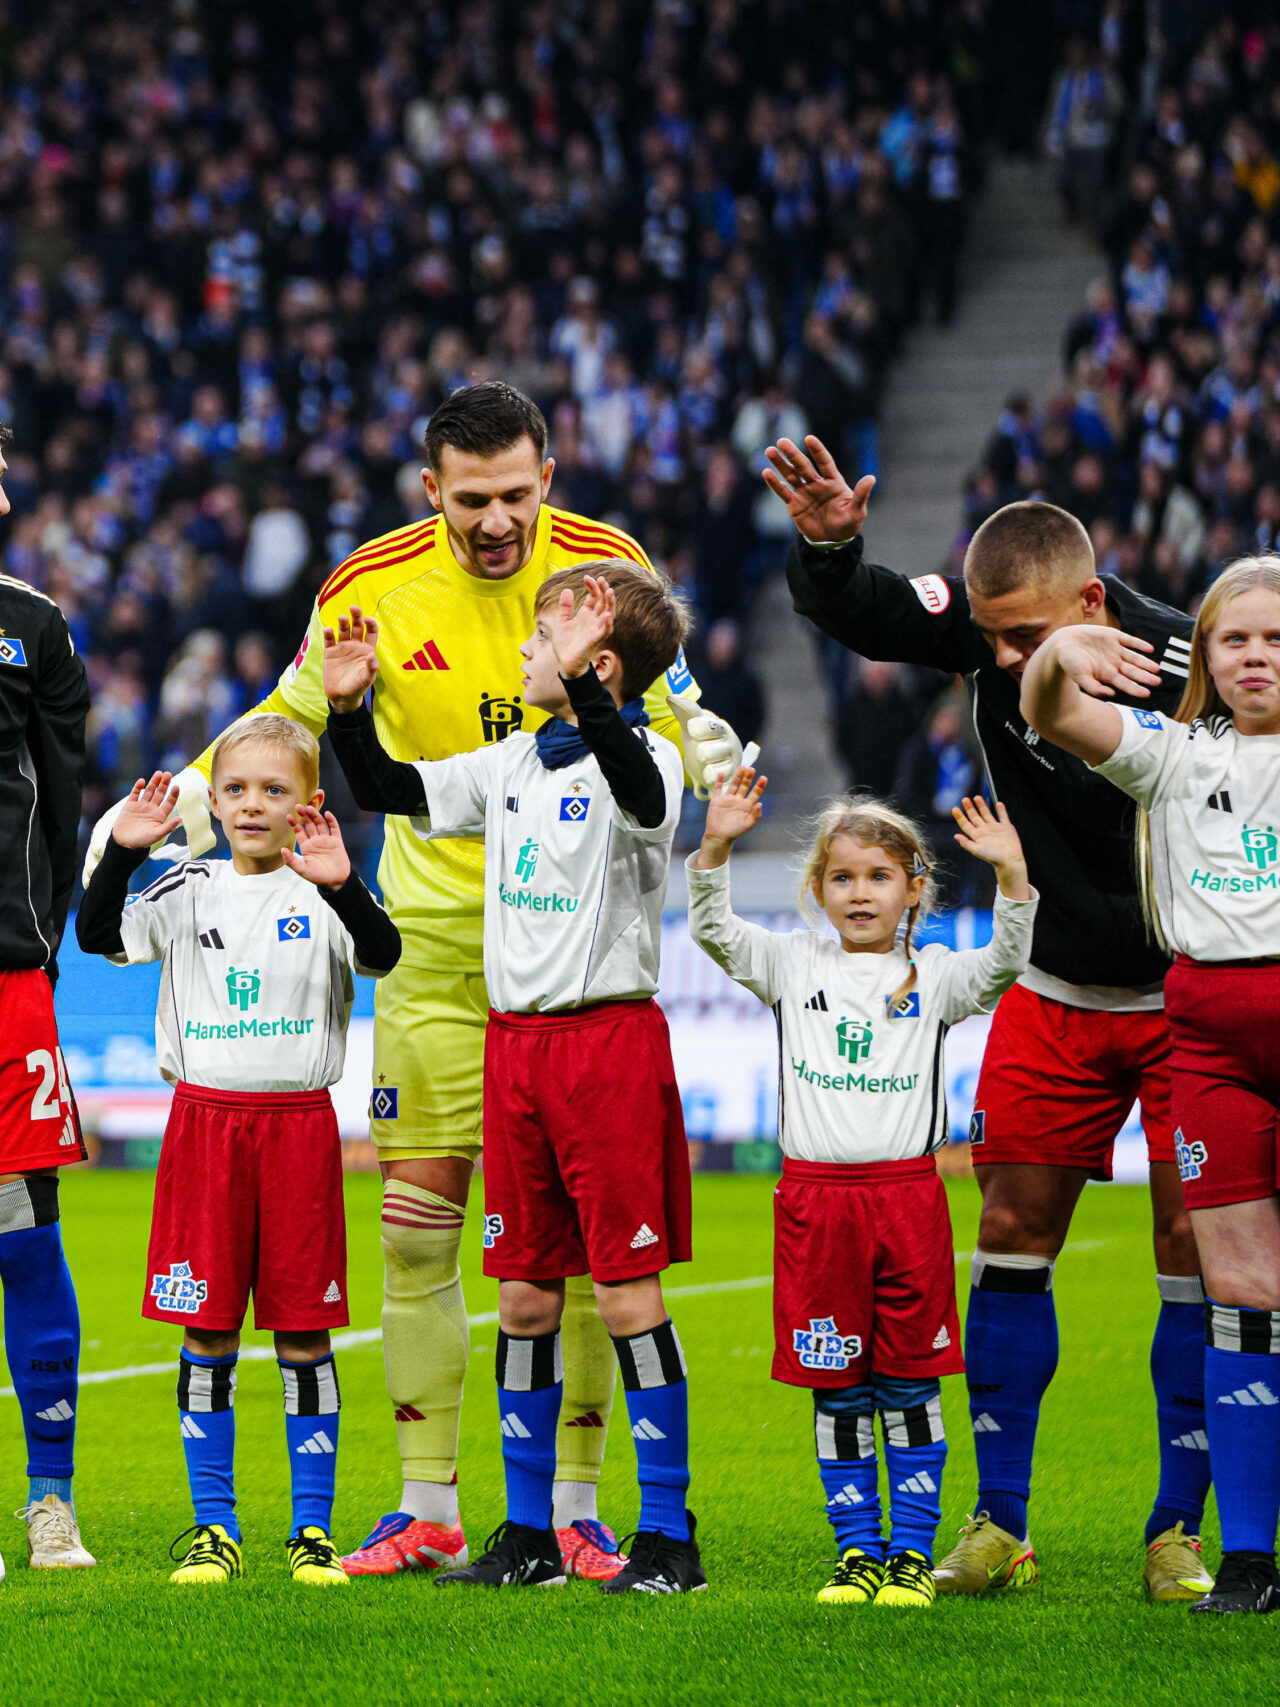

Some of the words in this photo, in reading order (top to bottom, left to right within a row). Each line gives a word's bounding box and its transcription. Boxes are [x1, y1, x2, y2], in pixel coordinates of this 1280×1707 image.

[184, 1016, 315, 1040] HanseMerkur
[26, 1046, 72, 1120] 24
[630, 1235, 659, 1249] adidas
[153, 1277, 206, 1300] KIDS
[158, 1297, 197, 1311] CLUB
[795, 1332, 859, 1356] KIDS
[31, 1356, 74, 1373] HSV
[802, 1353, 846, 1368] CLUB
